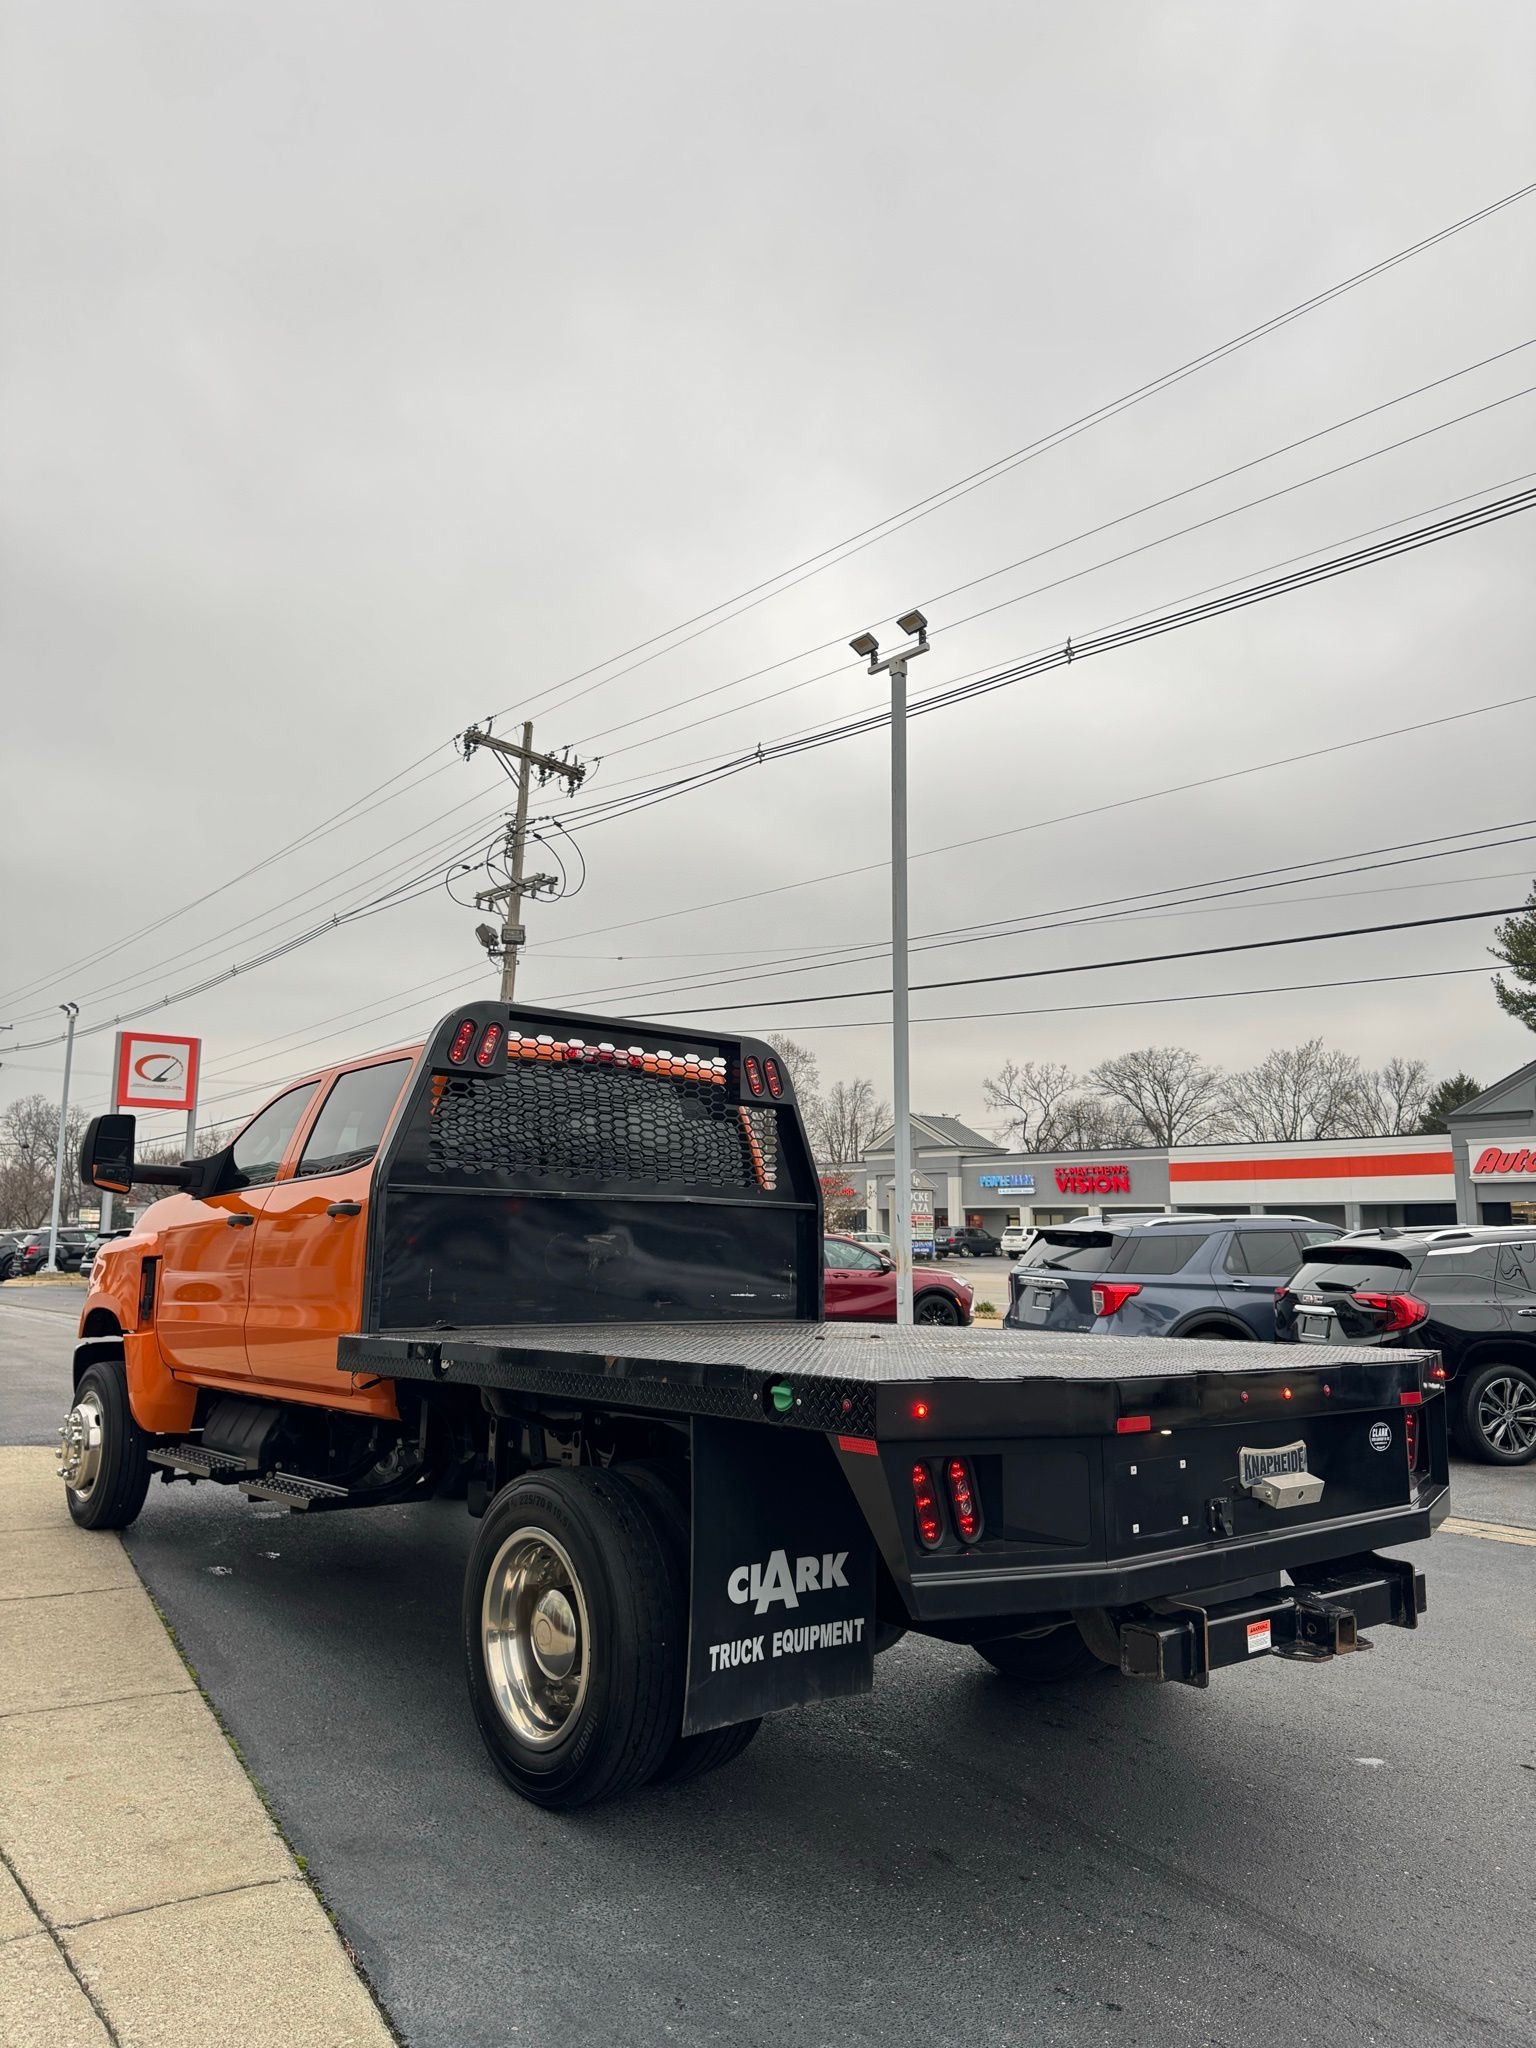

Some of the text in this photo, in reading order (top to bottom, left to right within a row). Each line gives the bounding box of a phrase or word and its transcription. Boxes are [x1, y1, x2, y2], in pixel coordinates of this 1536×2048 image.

[1055, 1175, 1130, 1194] VISION
[911, 1192, 929, 1202] CKE
[911, 1202, 929, 1212] AZA
[1372, 1427, 1388, 1438] CLARK
[1244, 1446, 1305, 1481] KNAPHEIDE
[727, 1549, 850, 1615] CLARK
[709, 1617, 865, 1672] TRUCK EQUIPMENT
